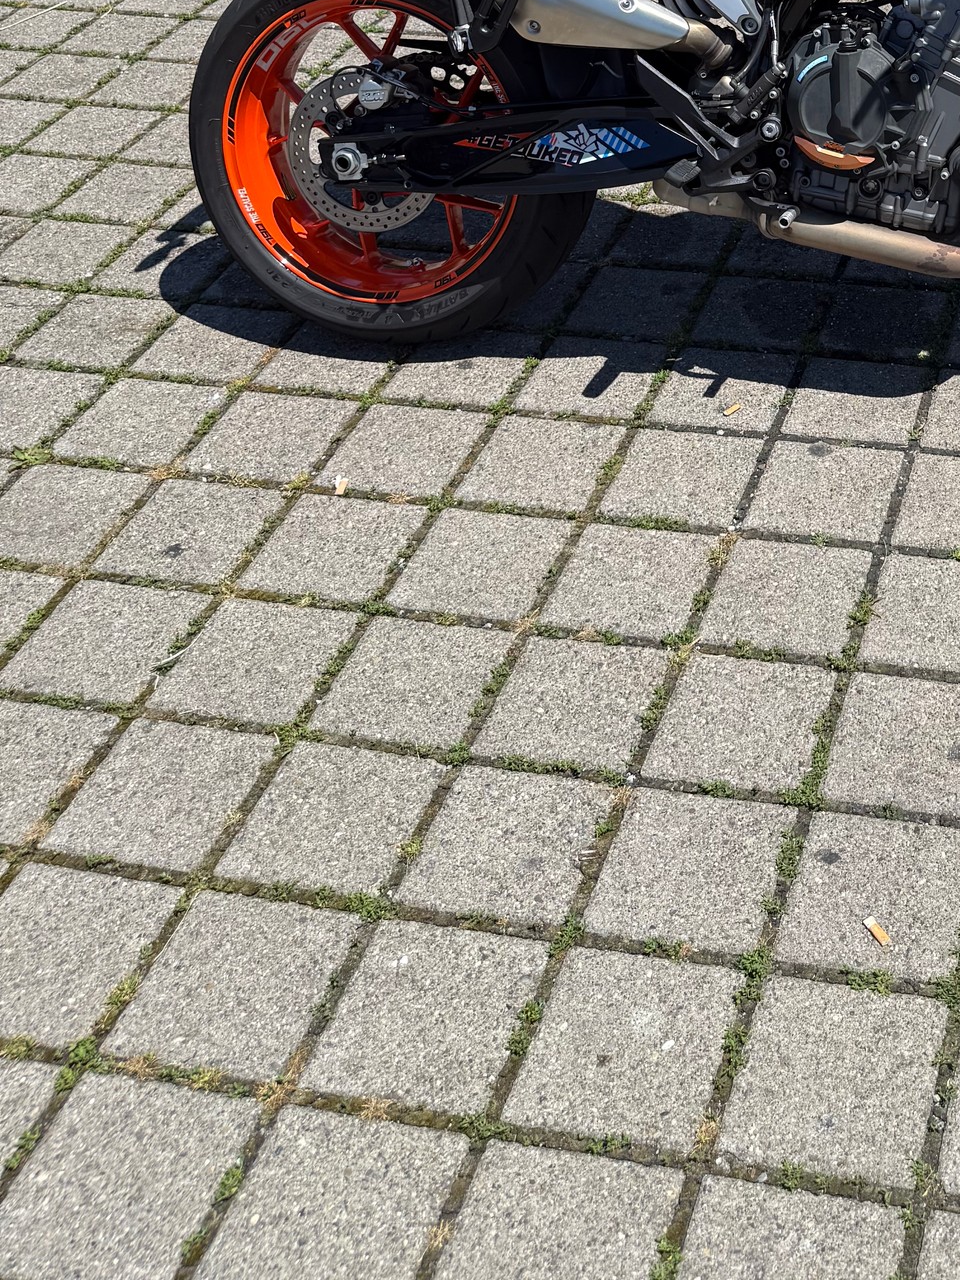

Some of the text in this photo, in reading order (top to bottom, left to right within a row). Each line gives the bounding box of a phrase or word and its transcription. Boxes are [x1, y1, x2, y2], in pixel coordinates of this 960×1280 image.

[361, 91, 386, 102] KTM
[824, 140, 846, 153] KTM
[255, 222, 274, 245] 790
[434, 273, 457, 289] 790
